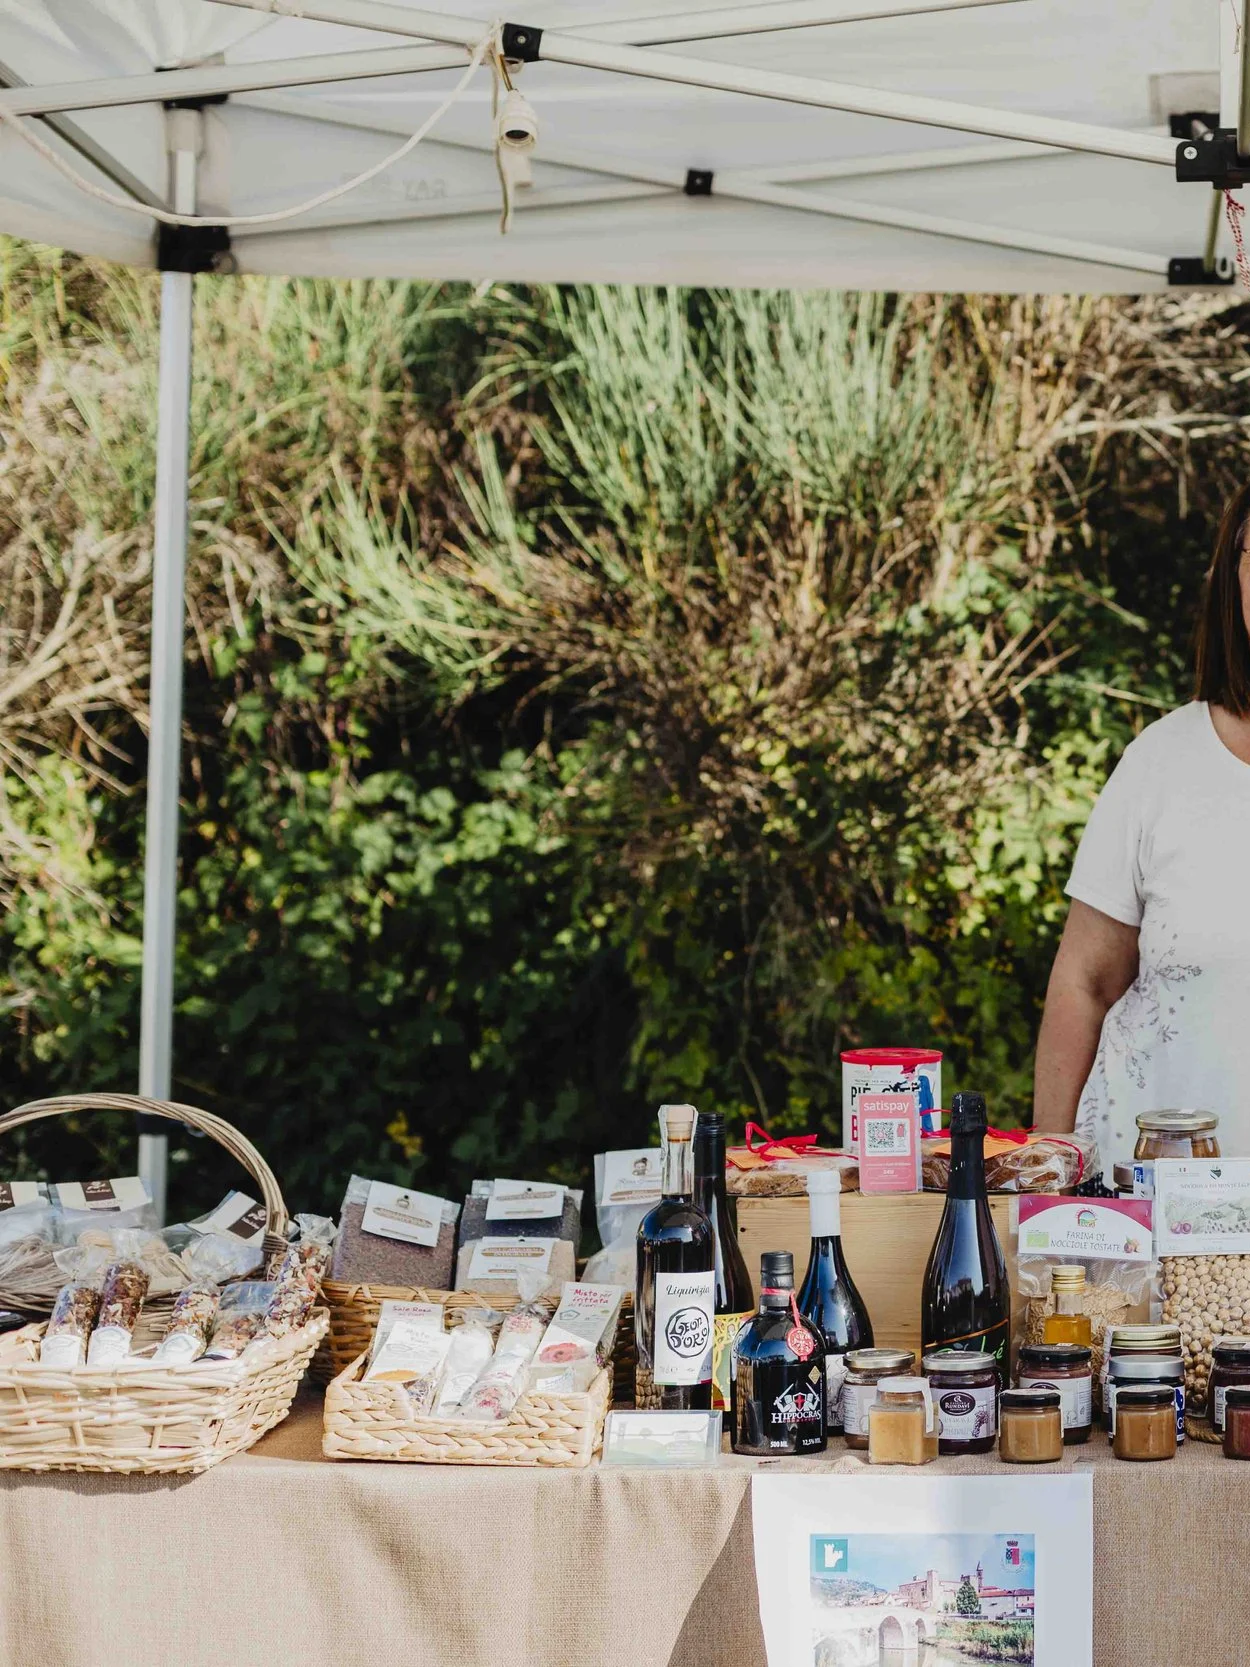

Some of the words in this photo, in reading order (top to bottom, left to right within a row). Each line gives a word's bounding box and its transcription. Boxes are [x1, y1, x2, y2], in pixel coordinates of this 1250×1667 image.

[863, 1100, 909, 1114] satispay
[1066, 1230, 1094, 1241] FARINA
[1096, 1232, 1105, 1241] DI
[1050, 1239, 1088, 1250] NOCCIOLE
[1089, 1243, 1121, 1252] TOSTATE
[573, 1288, 598, 1297] Misto
[666, 1284, 711, 1298] Liquirizia
[771, 1409, 822, 1424] HIPPOCRAS
